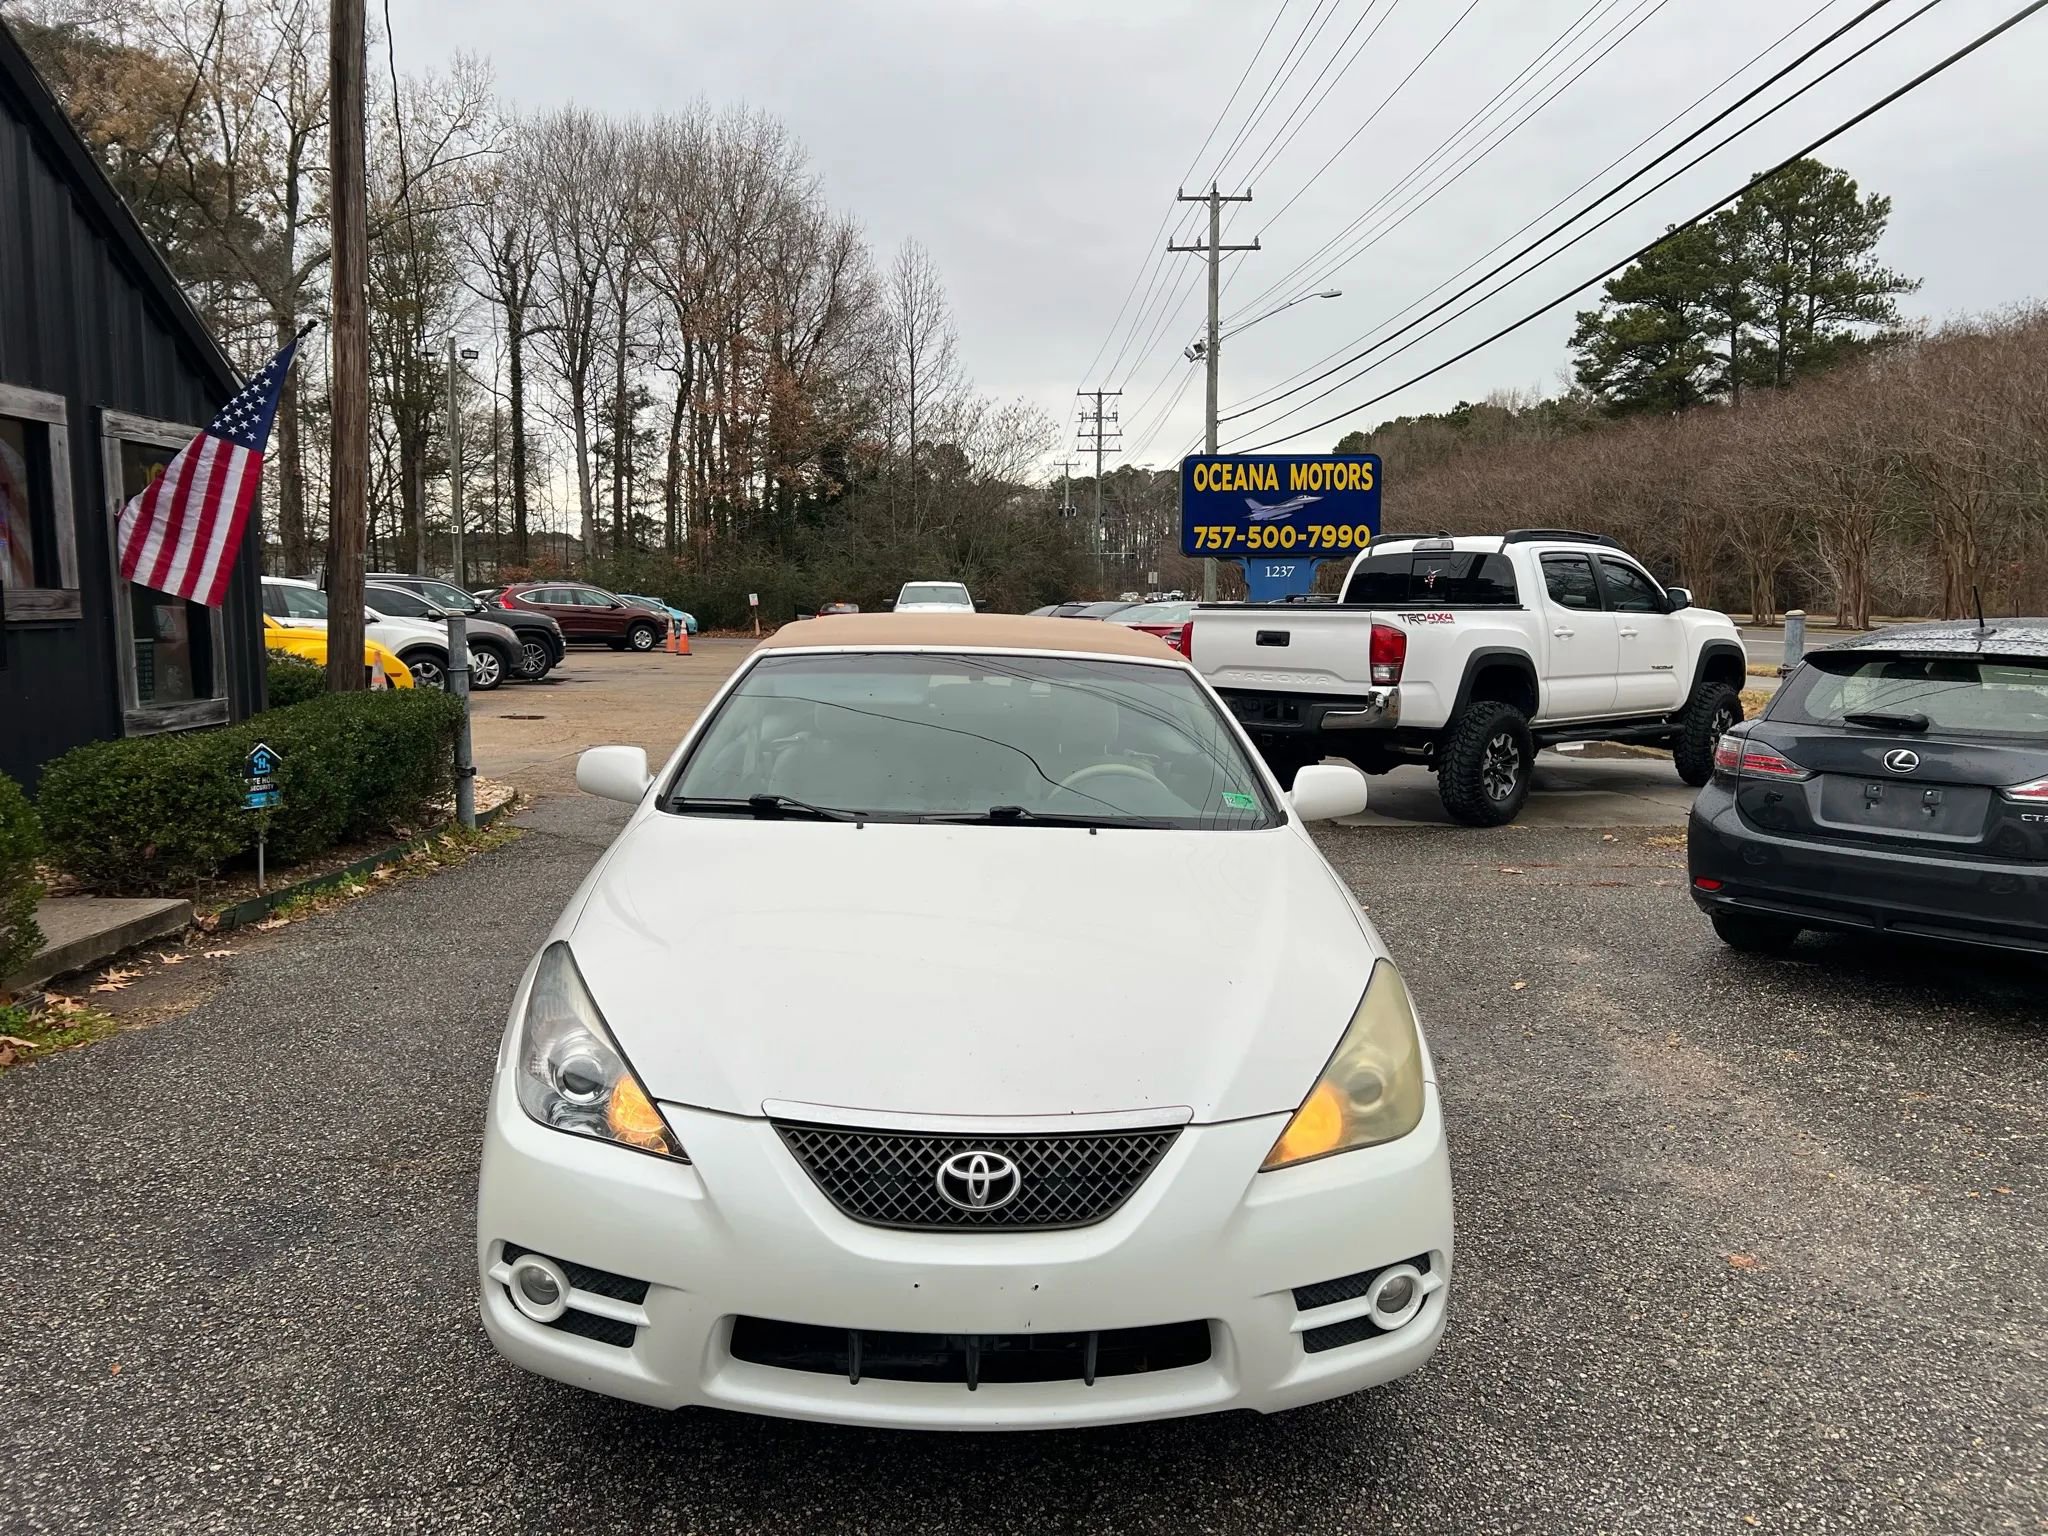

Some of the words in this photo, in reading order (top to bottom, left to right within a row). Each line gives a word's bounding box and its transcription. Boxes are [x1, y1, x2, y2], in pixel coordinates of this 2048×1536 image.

[1193, 463, 1279, 492] OCEANA
[1290, 462, 1374, 491] MOTORS
[1193, 525, 1371, 549] 757-500-7990
[1264, 566, 1295, 578] 1237
[1397, 613, 1427, 625] TRD
[1227, 671, 1330, 686] TACOMA
[250, 784, 274, 792] SECURITY
